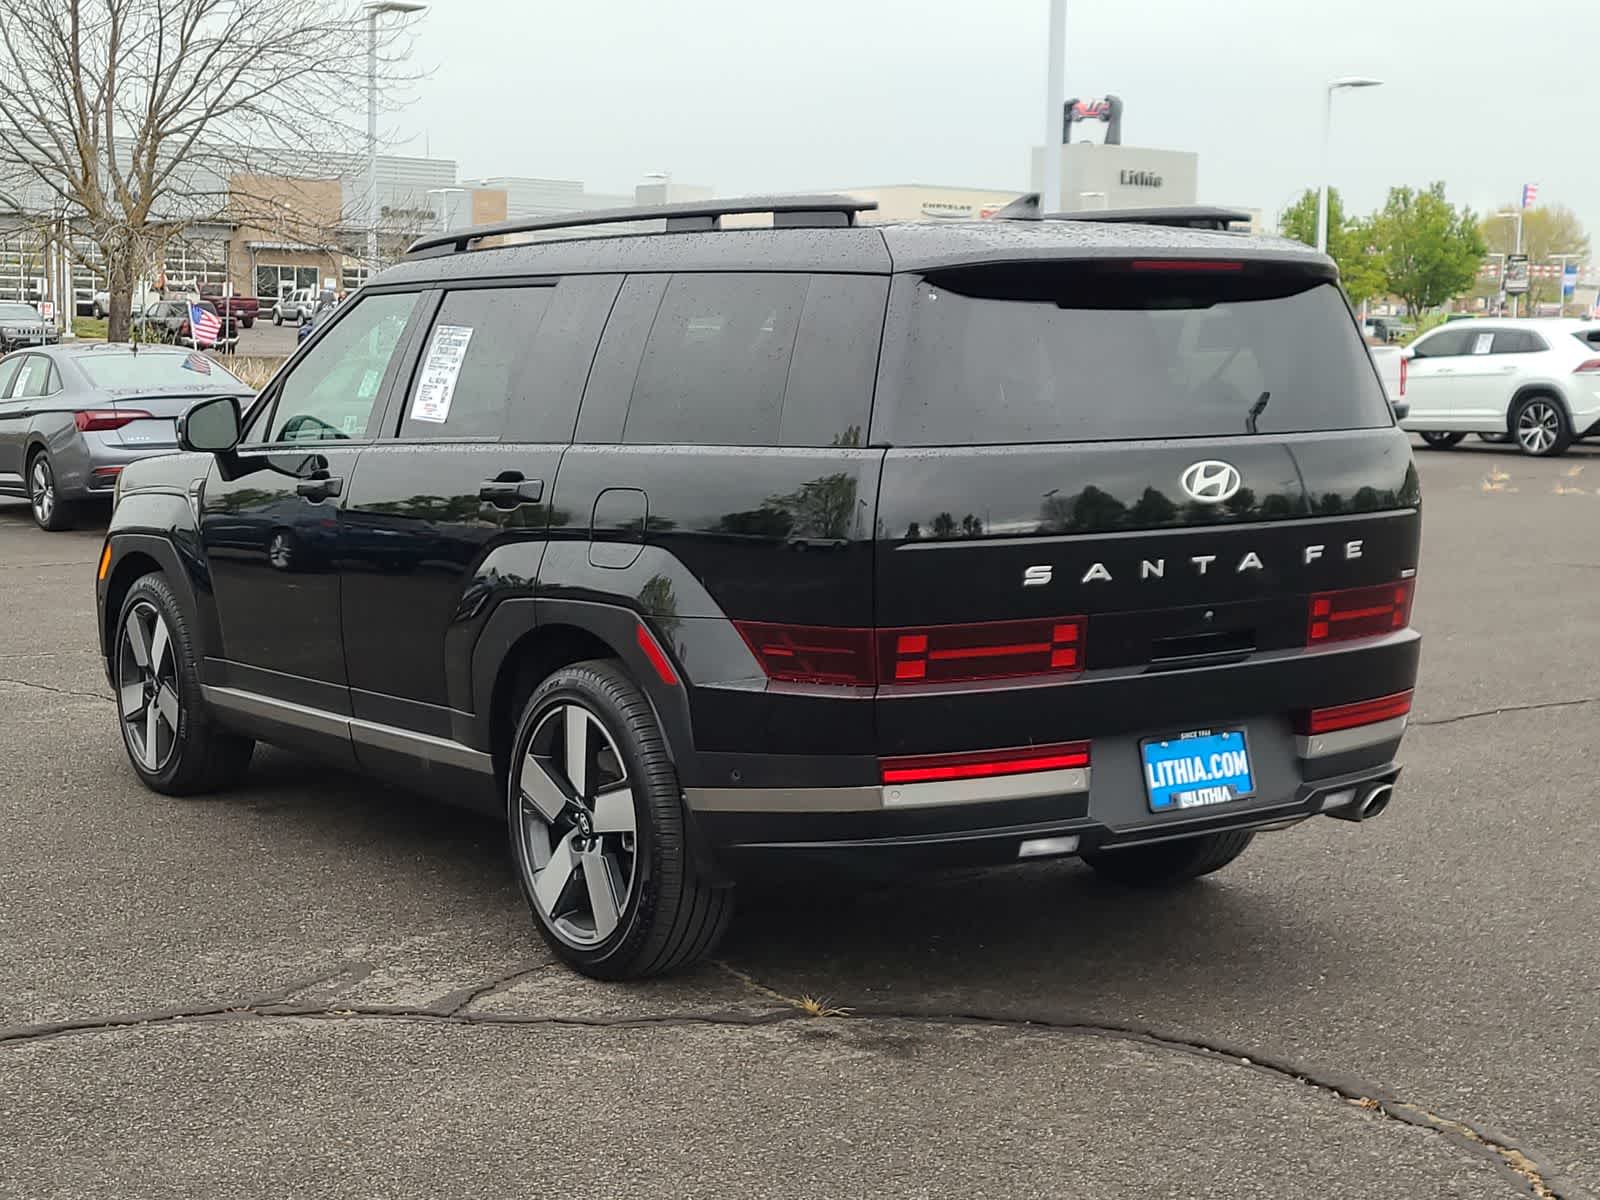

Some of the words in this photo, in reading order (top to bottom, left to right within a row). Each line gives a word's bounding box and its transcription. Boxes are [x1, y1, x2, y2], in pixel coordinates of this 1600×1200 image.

[1023, 551, 1264, 587] SANTA
[1304, 539, 1364, 564] FE
[1147, 750, 1249, 788] LITHIA.COM
[1193, 786, 1231, 805] LITHIA
